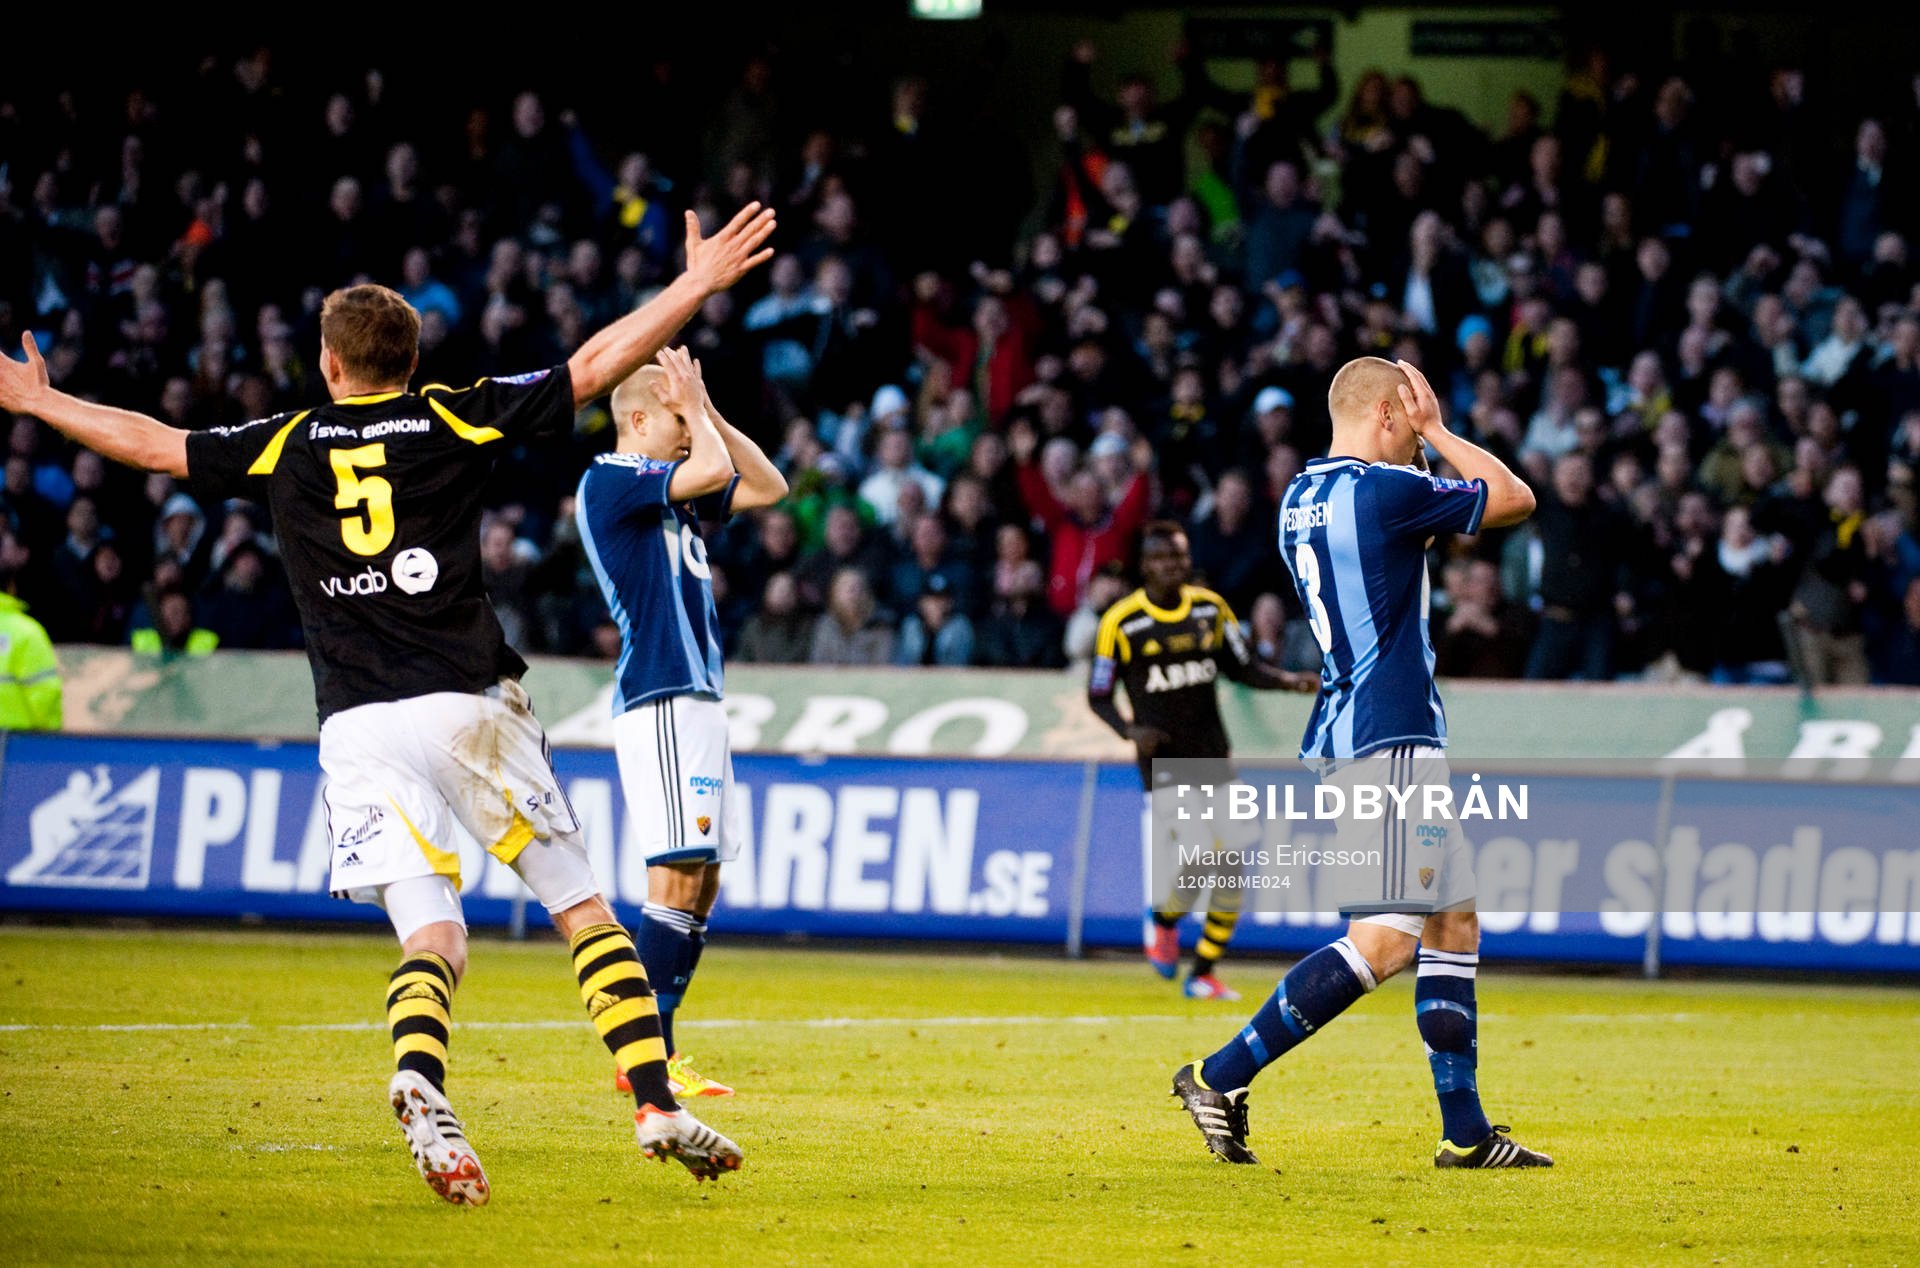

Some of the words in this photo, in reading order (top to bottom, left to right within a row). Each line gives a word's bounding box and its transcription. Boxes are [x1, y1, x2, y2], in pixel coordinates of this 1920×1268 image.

[361, 418, 431, 440] EKONOMI
[329, 443, 395, 557] 5
[1296, 543, 1332, 654] 3
[1652, 707, 1920, 783] ÅB
